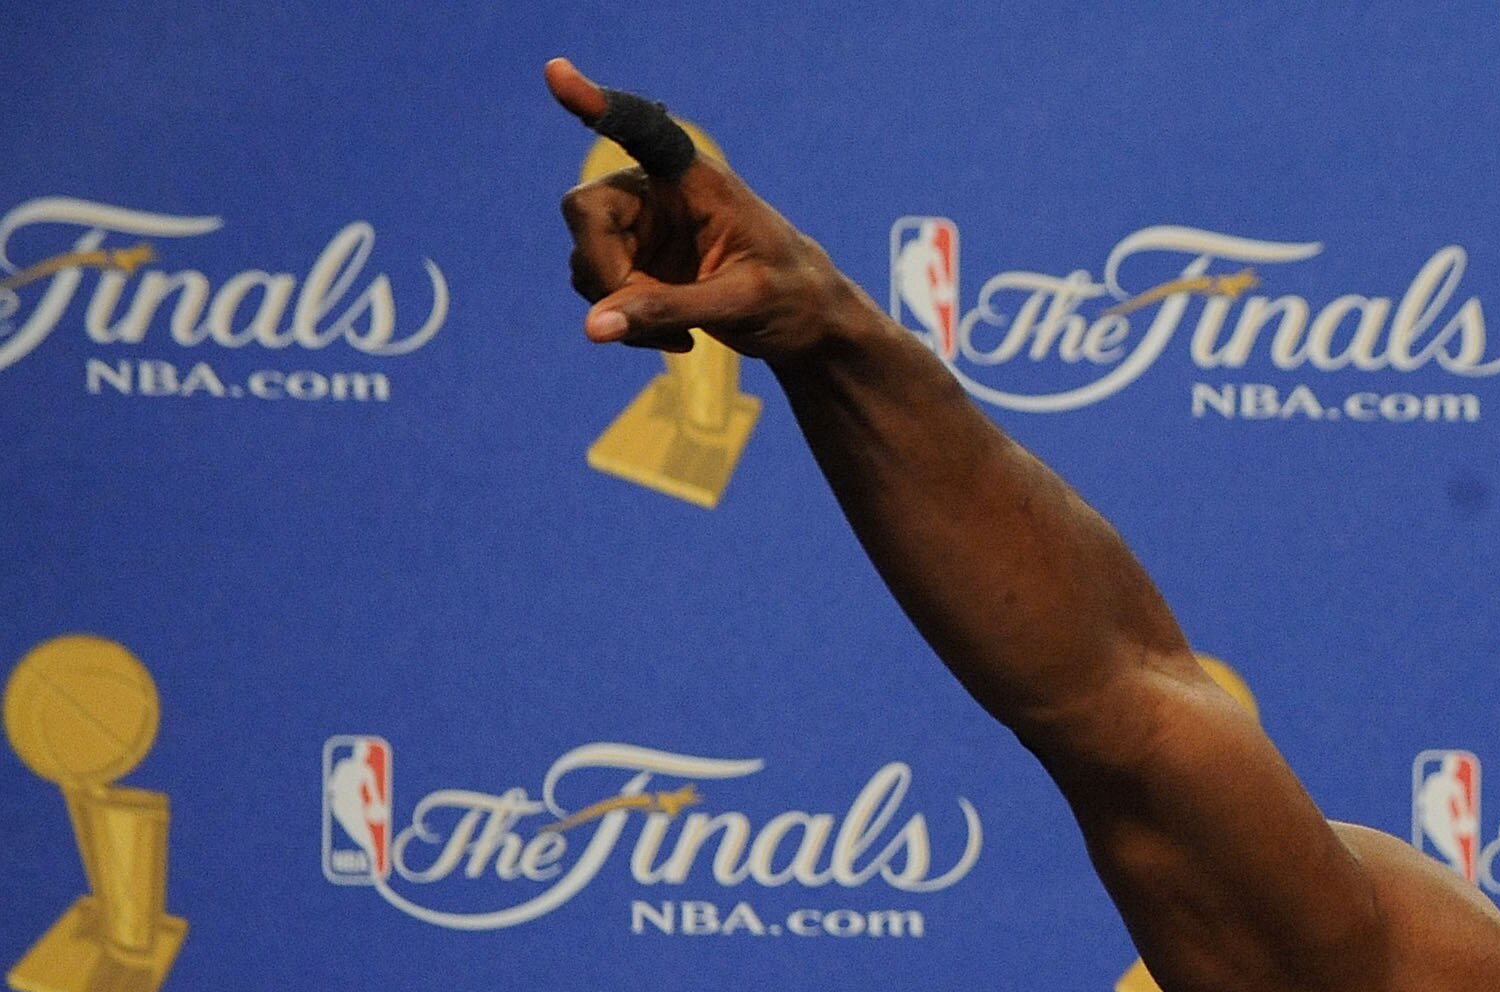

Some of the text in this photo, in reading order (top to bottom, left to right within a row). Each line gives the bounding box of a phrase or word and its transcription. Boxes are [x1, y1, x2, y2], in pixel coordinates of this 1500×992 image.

[960, 269, 1131, 366] The
[86, 358, 392, 401] NBA.com
[1190, 382, 1482, 421] NBA.com
[393, 742, 983, 924] The Finals
[631, 900, 924, 938] NBA.com
